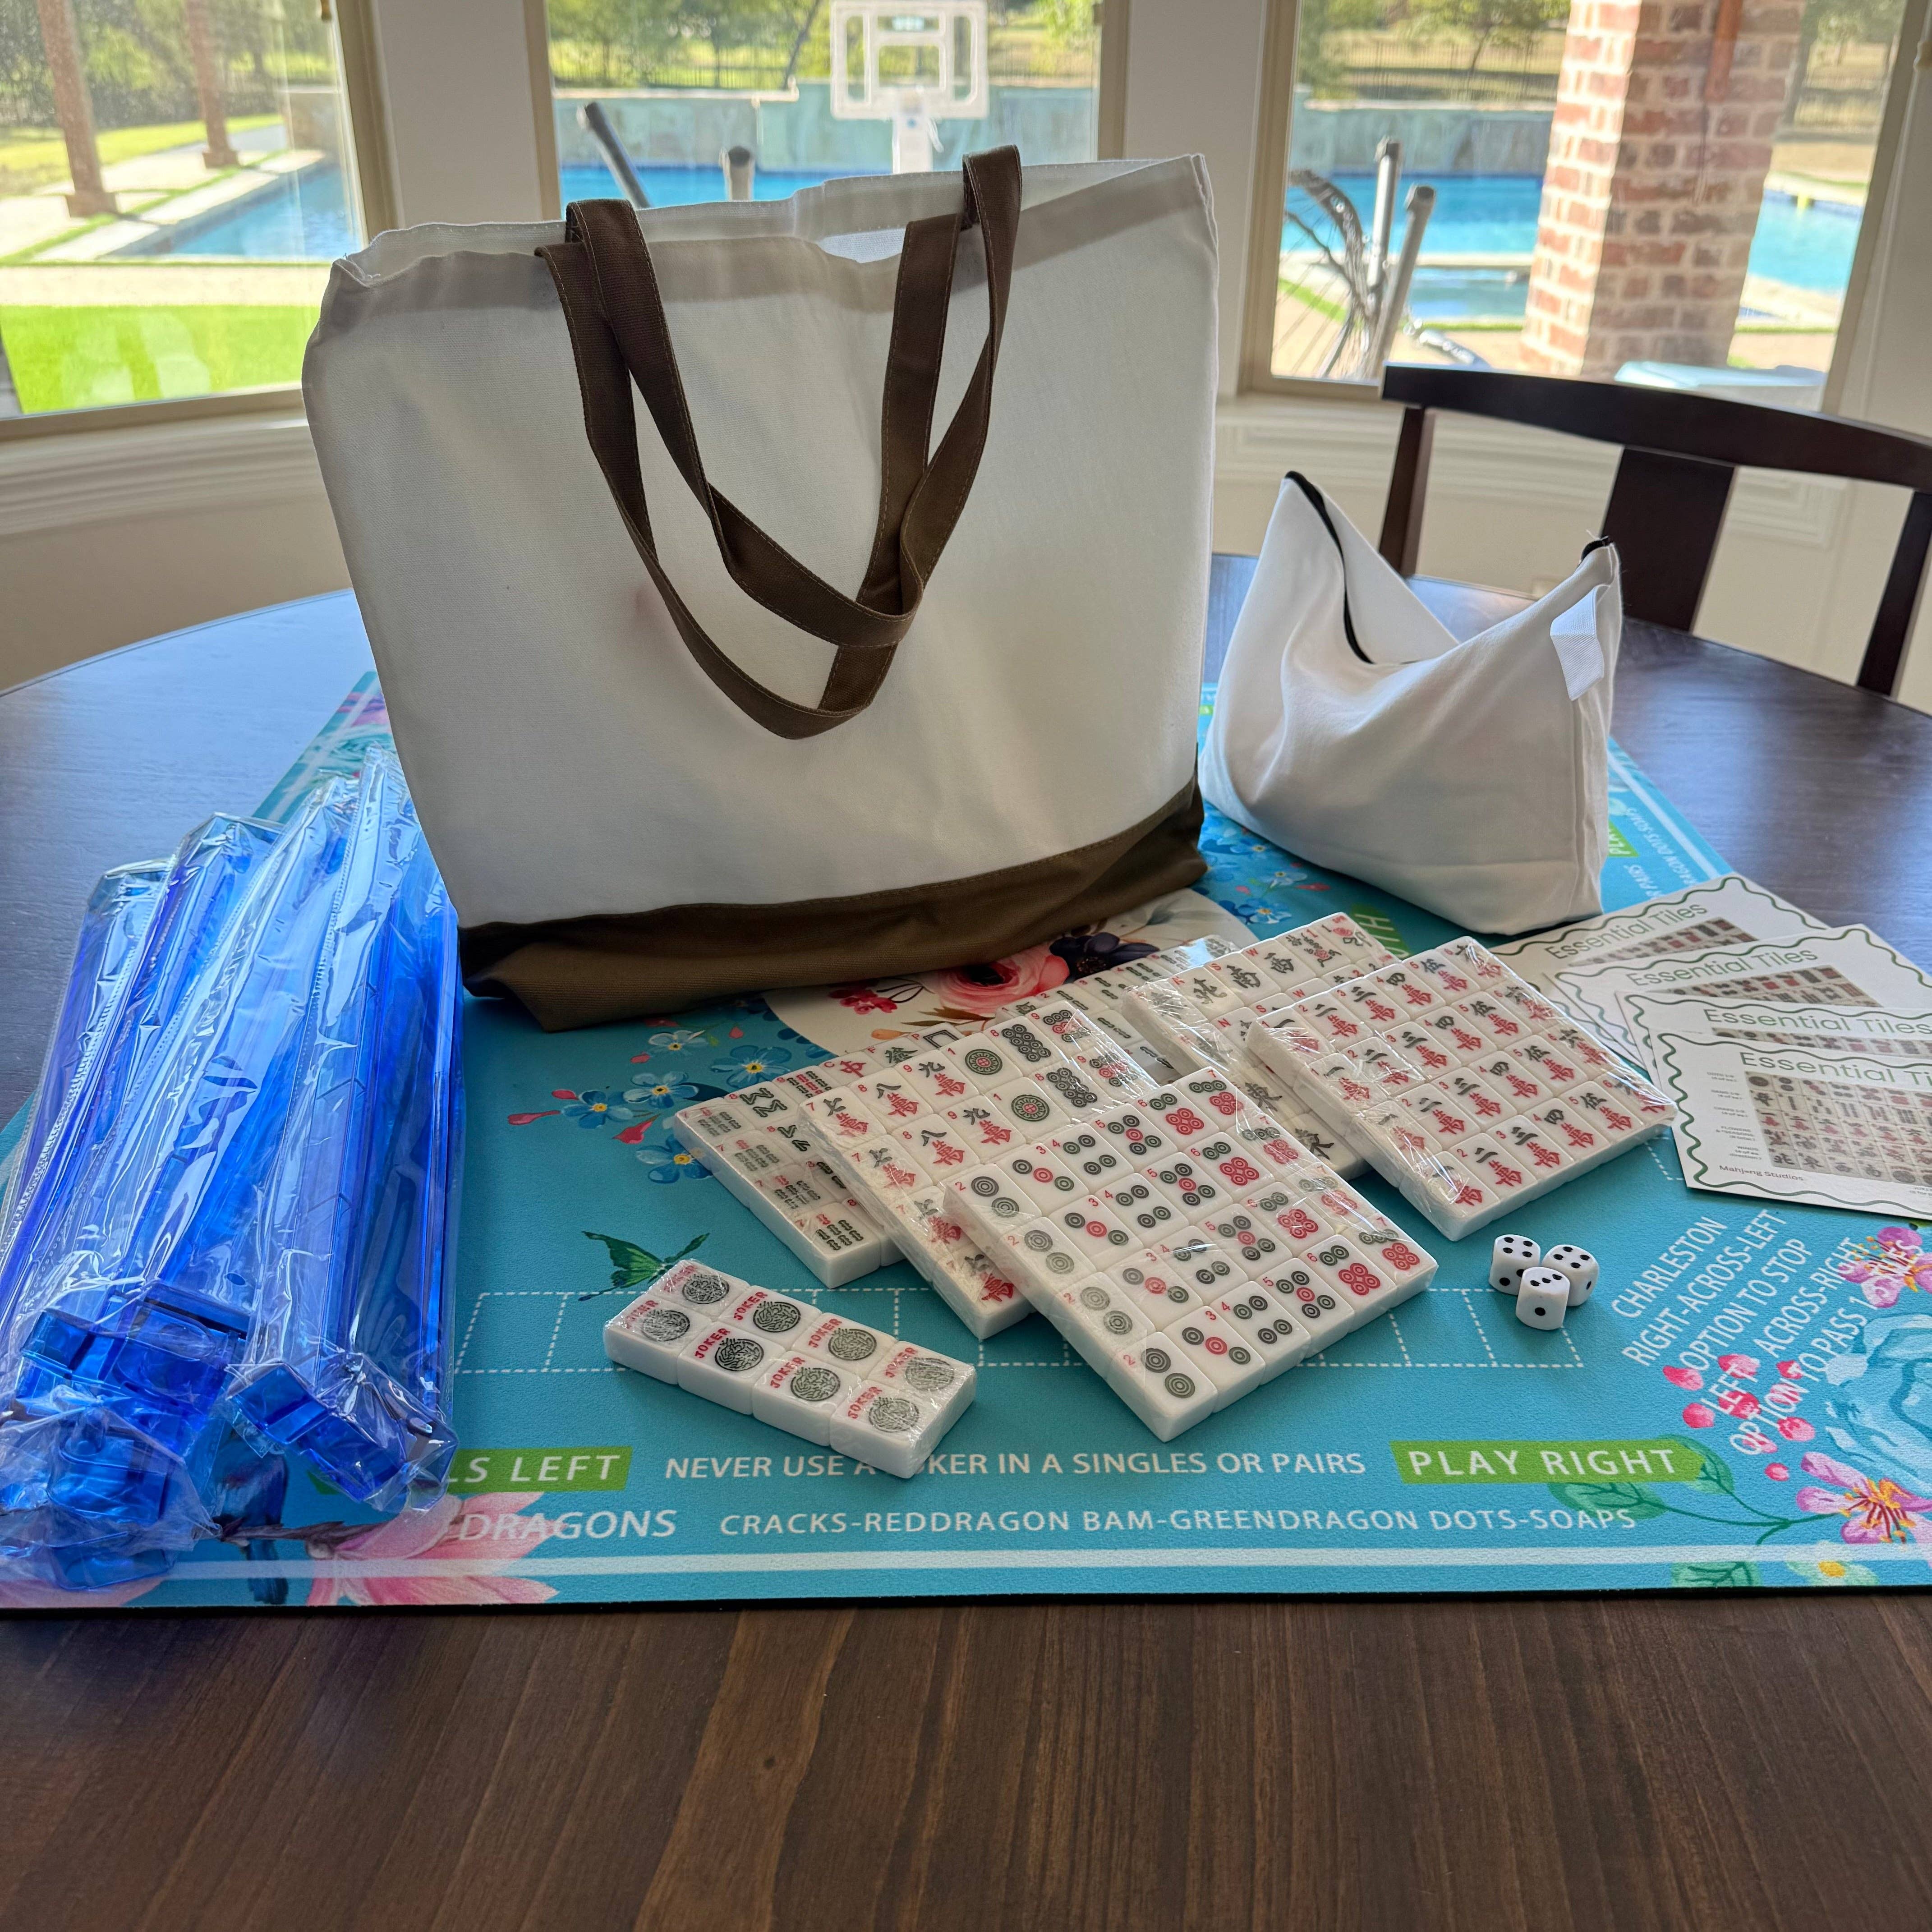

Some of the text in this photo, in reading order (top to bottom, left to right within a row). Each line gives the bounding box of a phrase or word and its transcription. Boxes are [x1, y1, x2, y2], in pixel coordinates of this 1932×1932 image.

[1545, 903, 1708, 960] Essential Tiles
[1210, 963, 1221, 971] S
[1625, 946, 1818, 987] Essential Tiles
[1256, 1005, 1266, 1013] S
[1703, 1008, 1932, 1035] Essential Tiles
[1387, 1035, 1396, 1043] 3
[1347, 1050, 1357, 1058] 2
[1740, 1052, 1897, 1083] Essential
[1903, 1071, 1932, 1086] Ti
[808, 1102, 814, 1112] 7
[1401, 1098, 1412, 1107] 2
[1094, 1120, 1105, 1129] 5
[902, 1131, 911, 1139] 8
[1496, 1131, 1506, 1139] 3
[1036, 1146, 1046, 1154] 3
[1457, 1150, 1467, 1158] 2
[852, 1152, 860, 1162] 7
[1147, 1169, 1157, 1178] 5
[1764, 1170, 1804, 1181] Studios
[955, 1182, 966, 1191] 2
[848, 1199, 856, 1207] 8
[1089, 1198, 1099, 1207] 3
[1246, 1200, 1256, 1208] 6
[1205, 1222, 1215, 1232] 5
[1006, 1235, 1017, 1248] 2
[1146, 1253, 1157, 1263] 3
[1306, 1253, 1316, 1262] 6
[1611, 1217, 1728, 1318] CHARLESTON
[1262, 1279, 1274, 1287] 5
[1622, 1210, 1787, 1366] RIGHT-ACROSS-LEFT
[1063, 1293, 1073, 1305] 2
[1679, 1238, 1813, 1371] OPTION TO STOP
[734, 1292, 766, 1321] JOKER
[1221, 1303, 1229, 1311] 4
[1205, 1311, 1216, 1321] 3
[1700, 1237, 1870, 1416] LEFT ACROSS-RIGHT
[808, 1318, 841, 1348] JOKER
[695, 1329, 729, 1359] JOKER
[884, 1347, 916, 1378] JOKER
[1124, 1355, 1135, 1366] 2
[770, 1357, 805, 1388] JOKER
[1729, 1378, 1809, 1455] OPTION
[1787, 1352, 1829, 1382] TO
[1810, 1307, 1868, 1357] PASS
[847, 1386, 882, 1420] JOKER
[666, 1457, 771, 1478] NEVER
[784, 1456, 843, 1476] USE
[999, 1454, 1030, 1473] IN
[1042, 1454, 1063, 1473] A
[1073, 1453, 1207, 1473] SINGLES
[1221, 1453, 1263, 1473] OR
[1272, 1454, 1365, 1473] PAIRS
[1408, 1449, 1674, 1475] PLAY RIGHT
[511, 1455, 620, 1481] LEFT
[457, 1508, 677, 1541] DRAGONS
[721, 1509, 1635, 1535] CRACKS-REDDRAGON BAM-GREENDRAGON DOTS-SOAPS
